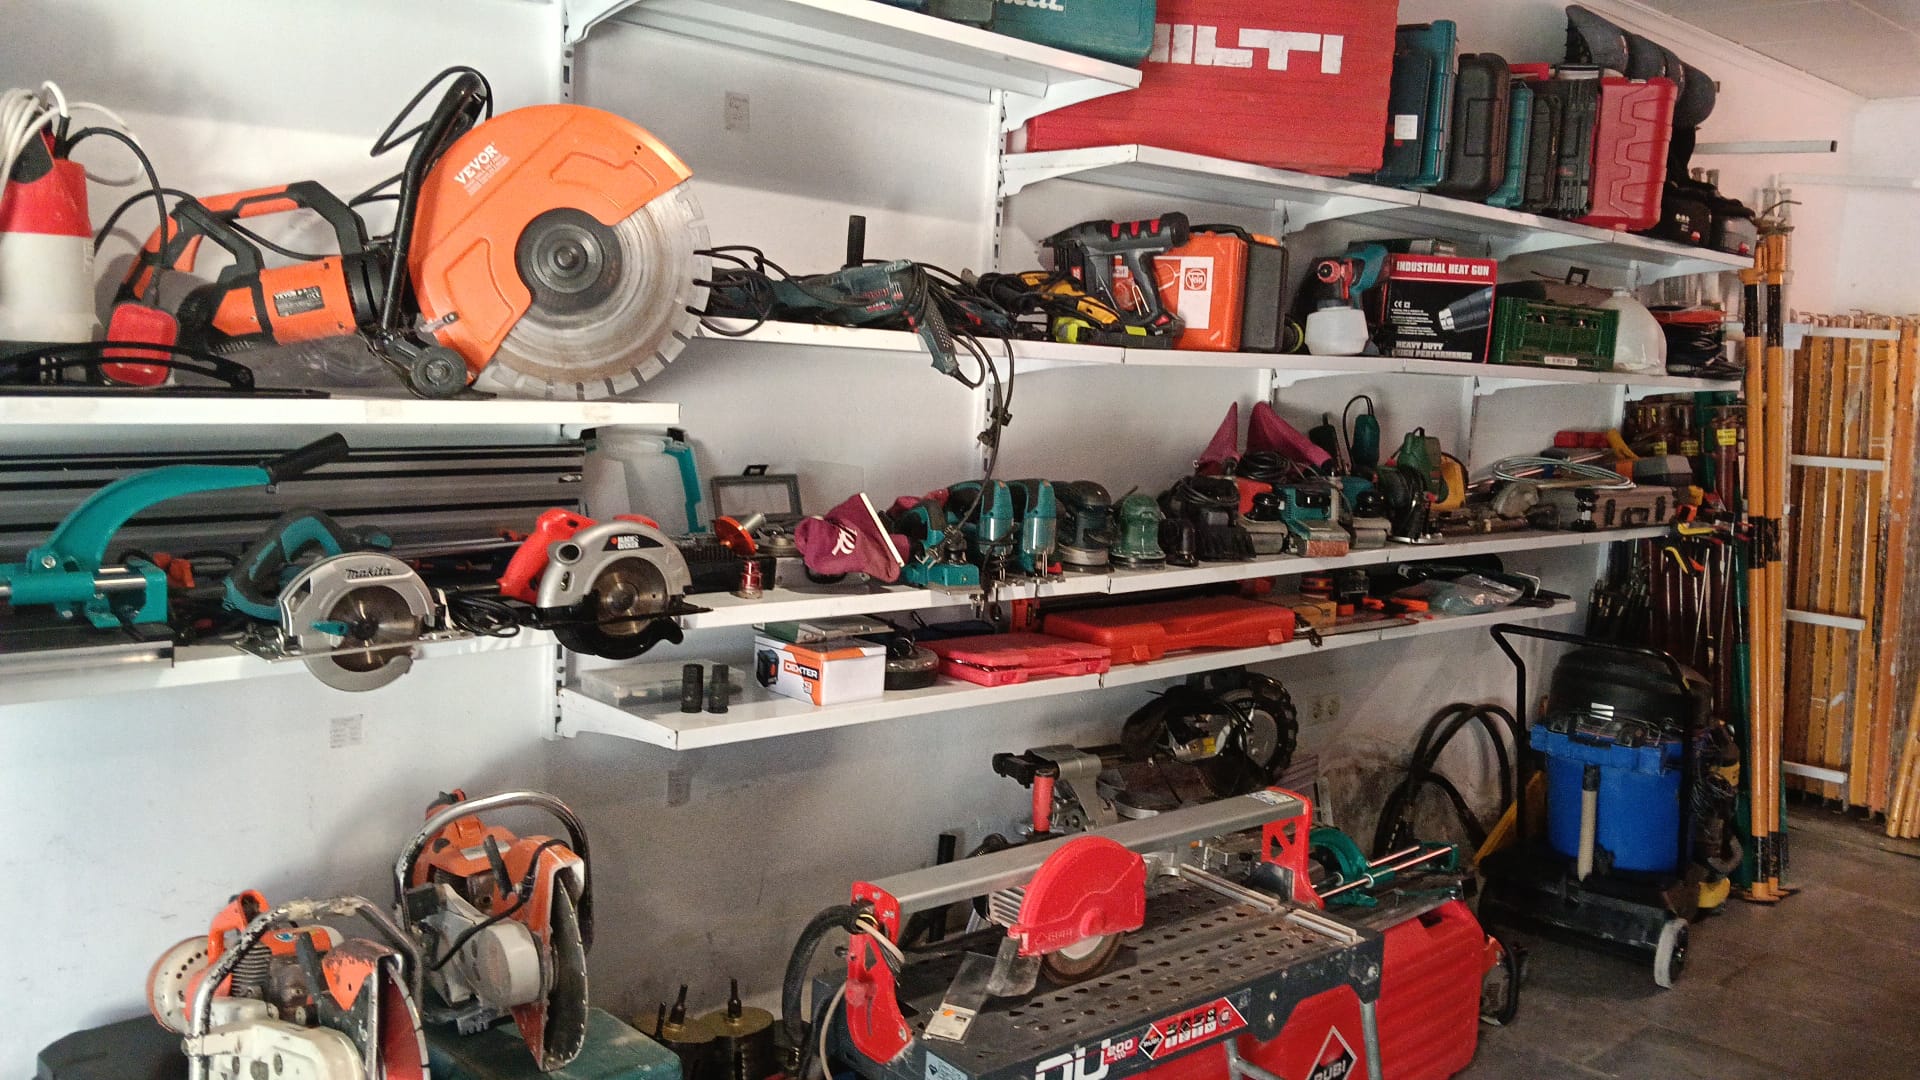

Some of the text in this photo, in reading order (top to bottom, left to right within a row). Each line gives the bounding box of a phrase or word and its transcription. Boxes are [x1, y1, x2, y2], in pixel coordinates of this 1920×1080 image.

[453, 144, 498, 186] VEVOR
[1396, 261, 1490, 277] INDUSTRIAL HEAT GUN
[1395, 340, 1445, 351] HEAVY DUTY
[1391, 348, 1473, 361] HIGH PERFORMANCE
[785, 662, 818, 680] DEXTER
[1107, 1038, 1133, 1057] 200
